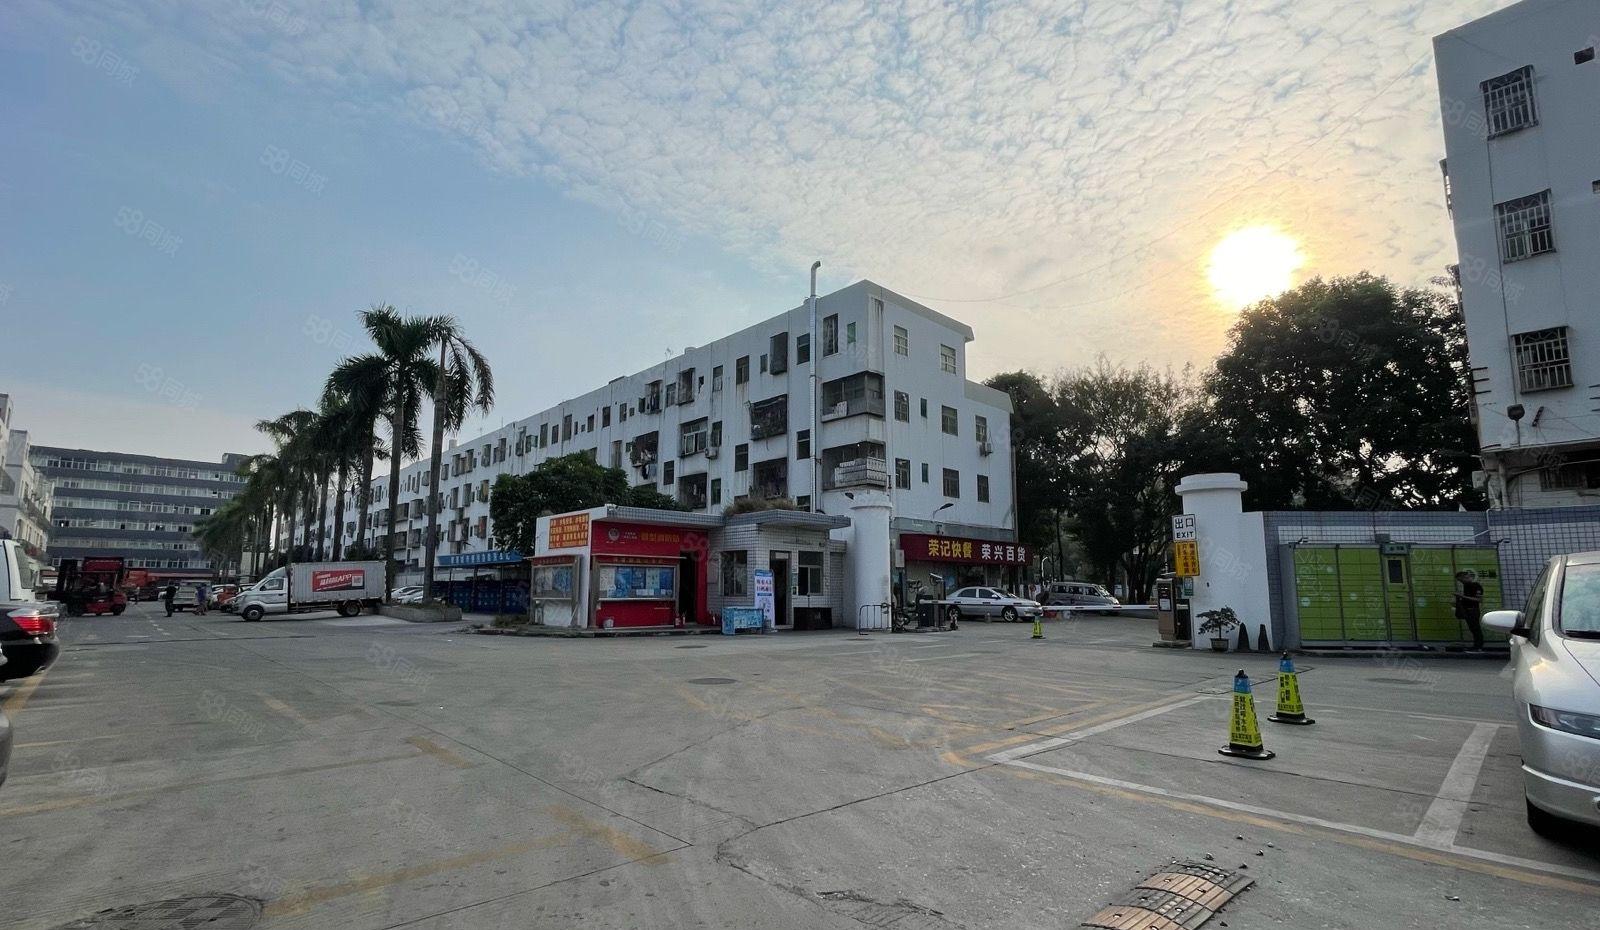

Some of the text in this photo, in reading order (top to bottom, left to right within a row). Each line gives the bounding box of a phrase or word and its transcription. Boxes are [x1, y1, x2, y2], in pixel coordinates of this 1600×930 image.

[1175, 518, 1194, 529] 出口
[928, 539, 1026, 562] 荣记快餐 荣兴百货
